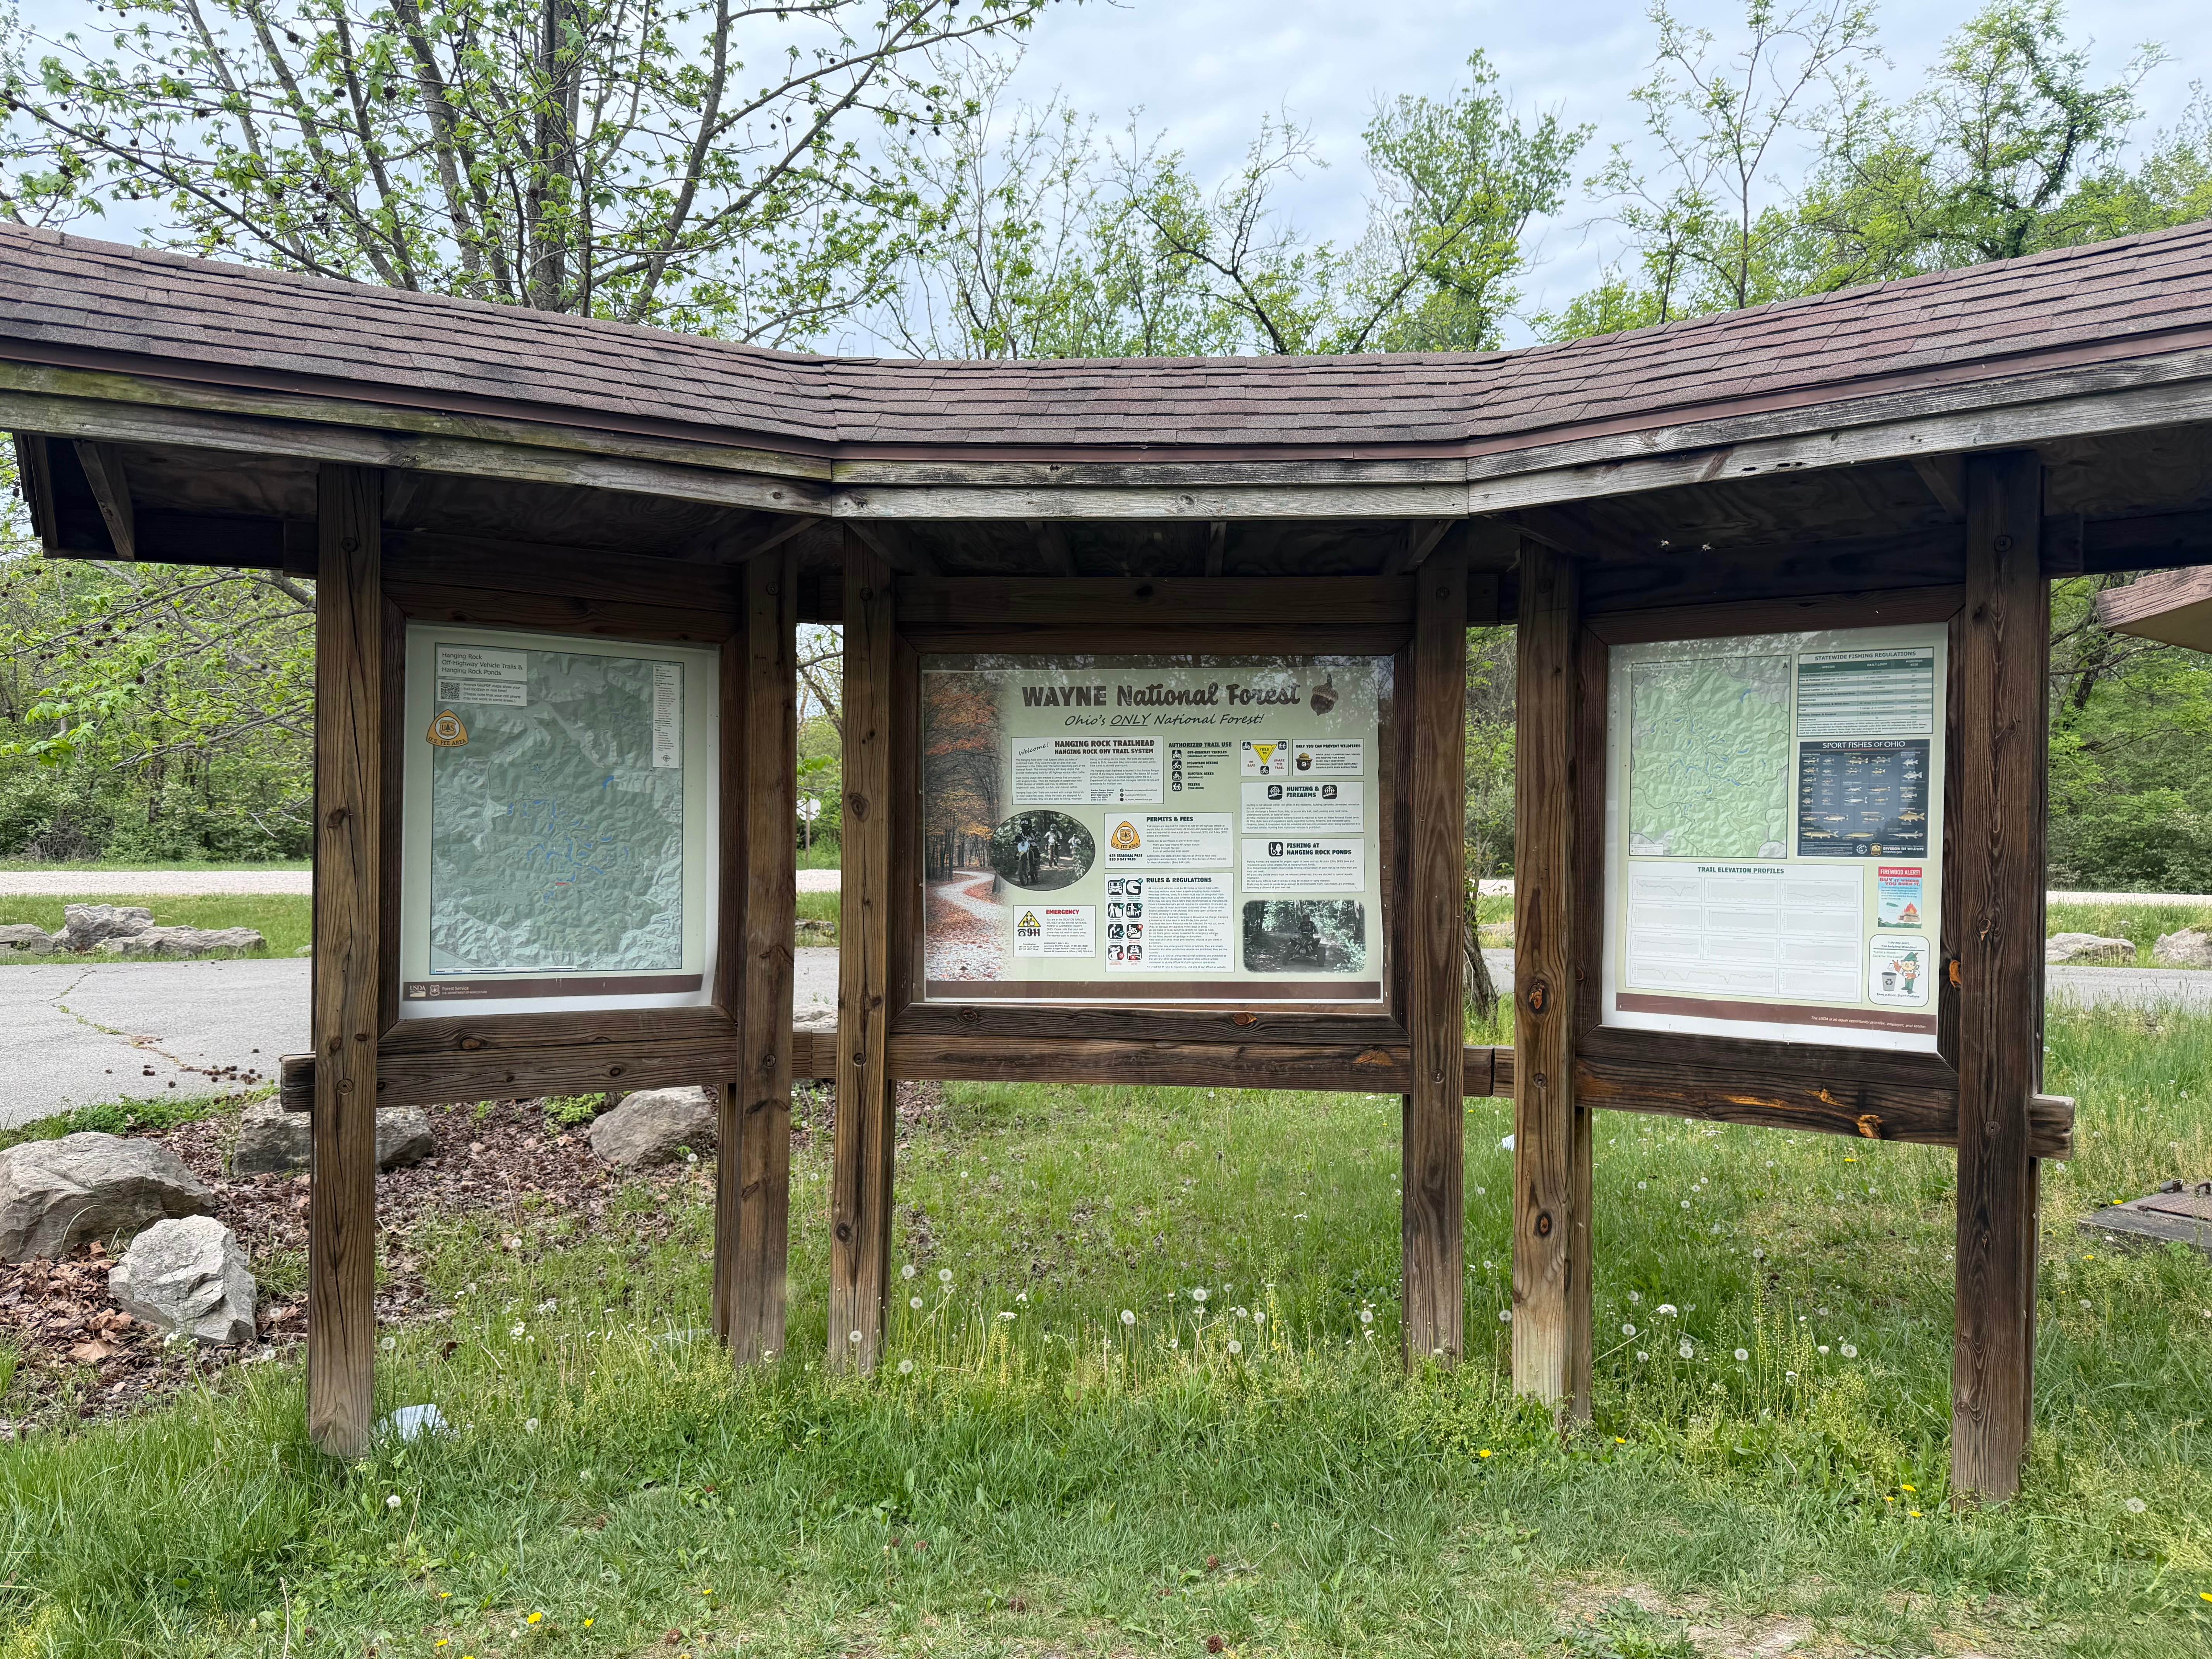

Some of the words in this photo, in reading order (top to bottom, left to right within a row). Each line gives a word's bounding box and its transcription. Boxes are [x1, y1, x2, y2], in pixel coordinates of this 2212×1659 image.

[1022, 686, 1106, 707] WAYNE
[1117, 684, 1219, 706] National
[1226, 684, 1300, 706] Forest
[1065, 714, 1106, 726] Ohio's
[1110, 714, 1151, 726] ONLY
[1154, 713, 1215, 725] National
[1219, 714, 1264, 725] Forest!
[1018, 742, 1049, 756] Welcome!
[1027, 928, 1040, 936] 911
